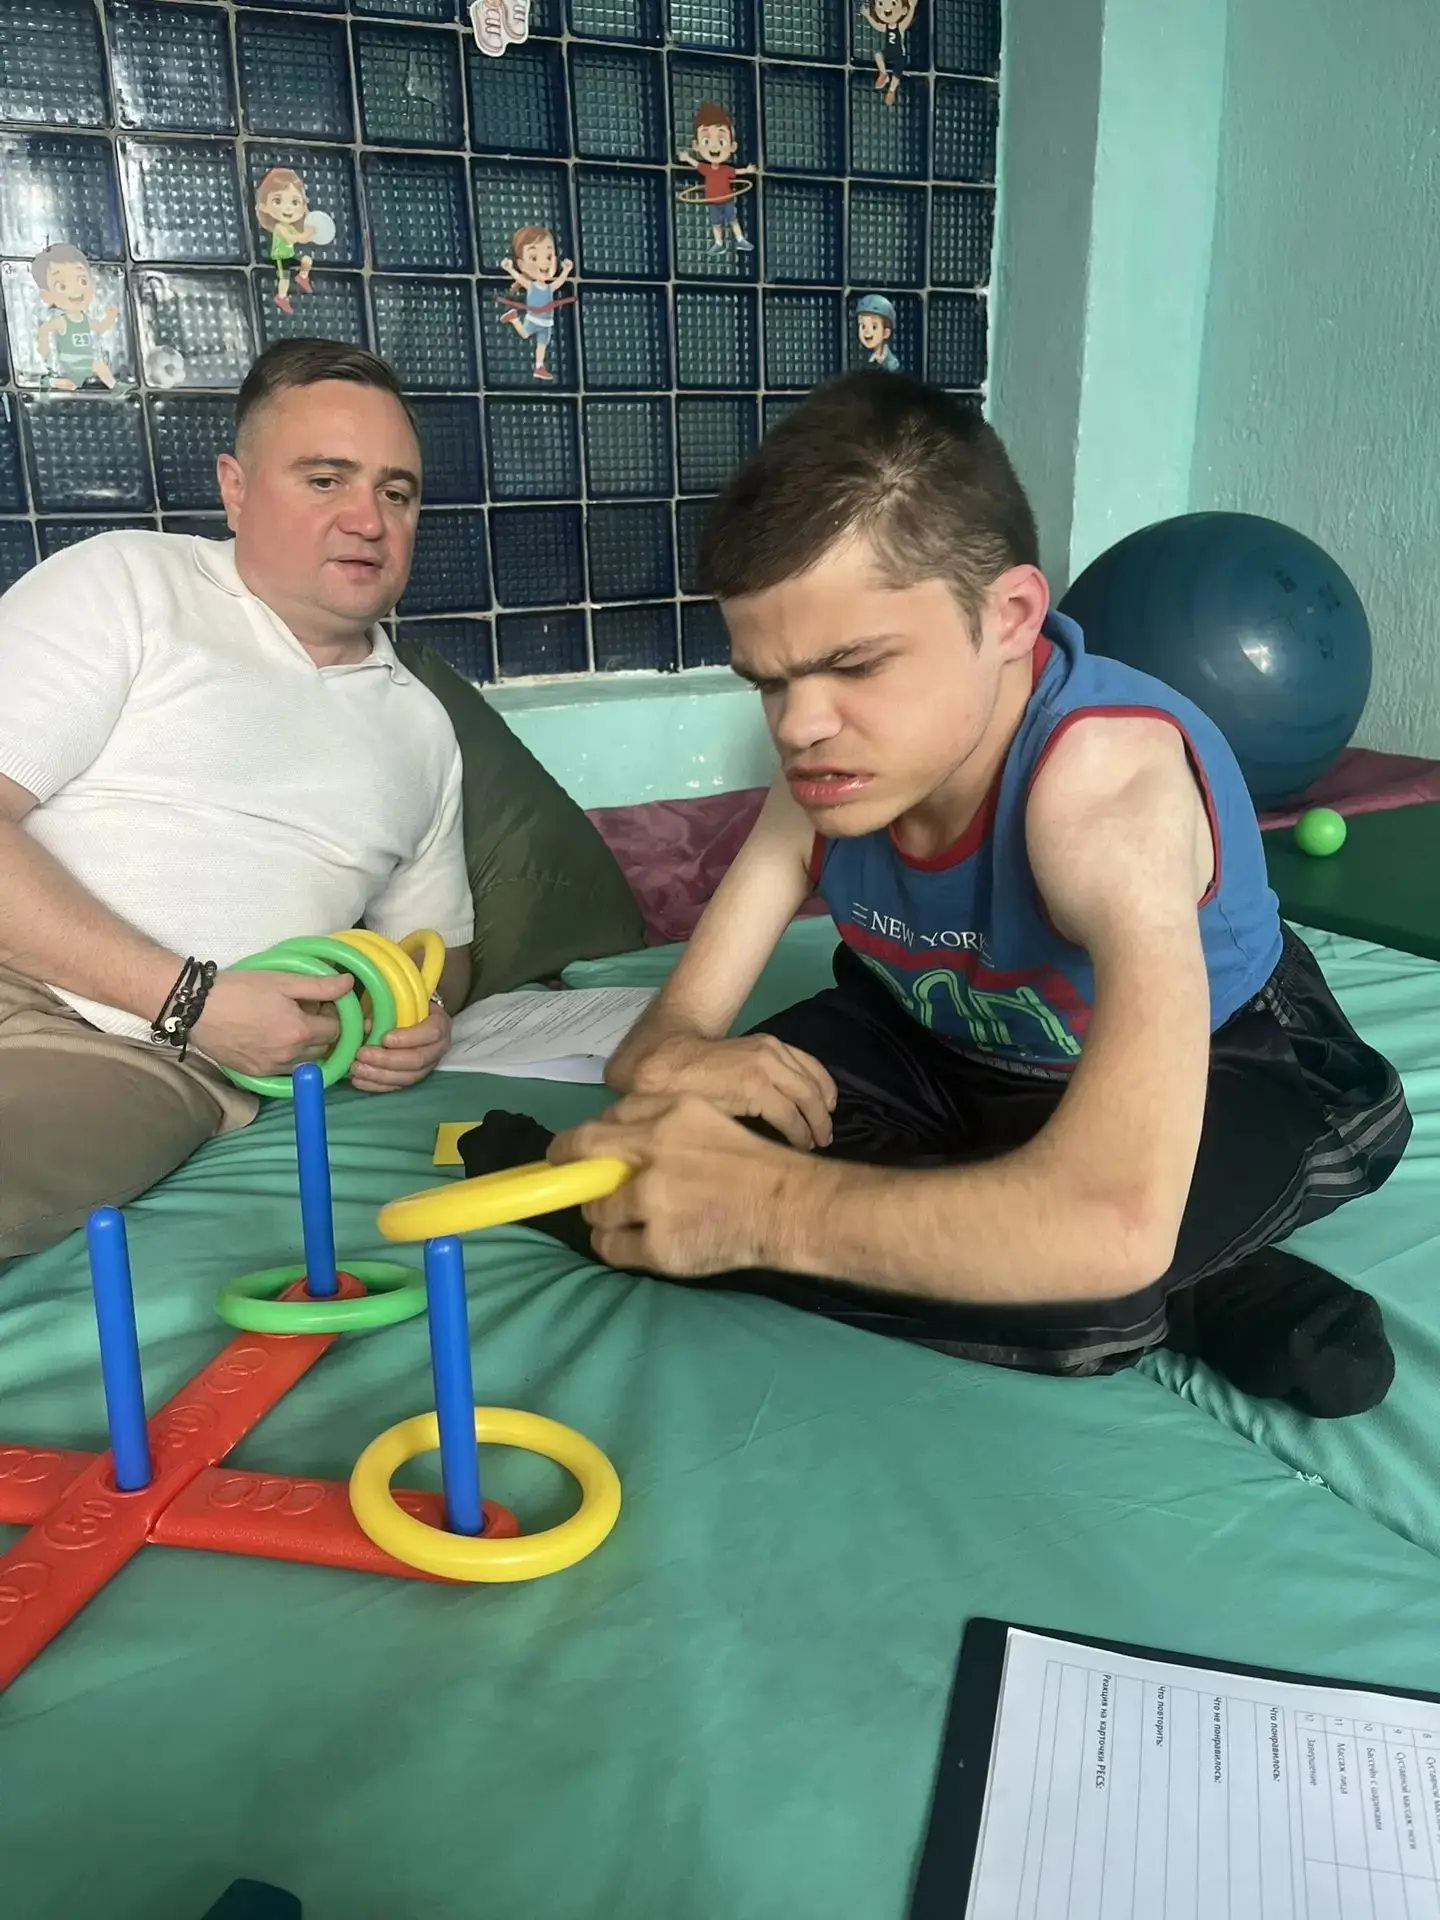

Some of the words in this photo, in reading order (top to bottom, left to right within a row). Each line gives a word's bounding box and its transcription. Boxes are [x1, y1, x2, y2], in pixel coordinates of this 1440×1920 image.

[888, 31, 897, 45] 2
[871, 910, 915, 947] NEW
[1100, 1674, 1112, 1707] Реакция
[1156, 1685, 1166, 1700] Что
[1213, 1696, 1223, 1711] Что
[1100, 1708, 1107, 1719] на
[1154, 1701, 1165, 1748] повторить:
[1214, 1712, 1221, 1722] не
[1269, 1706, 1279, 1721] Что
[1305, 1714, 1314, 1722] 12
[1334, 1718, 1343, 1726] 11
[1363, 1723, 1374, 1732] 10
[1097, 1720, 1107, 1762] карточки
[1211, 1724, 1222, 1784] понравилось:
[1268, 1722, 1281, 1782] понравилось:
[1307, 1737, 1318, 1786] Завершение
[1336, 1742, 1346, 1773] Массаж
[1366, 1747, 1378, 1780] Бассейн
[1095, 1764, 1106, 1790] PECS:
[1340, 1775, 1348, 1795] лица
[1395, 1751, 1411, 1794] Суставной
[1403, 1795, 1414, 1826] массаж
